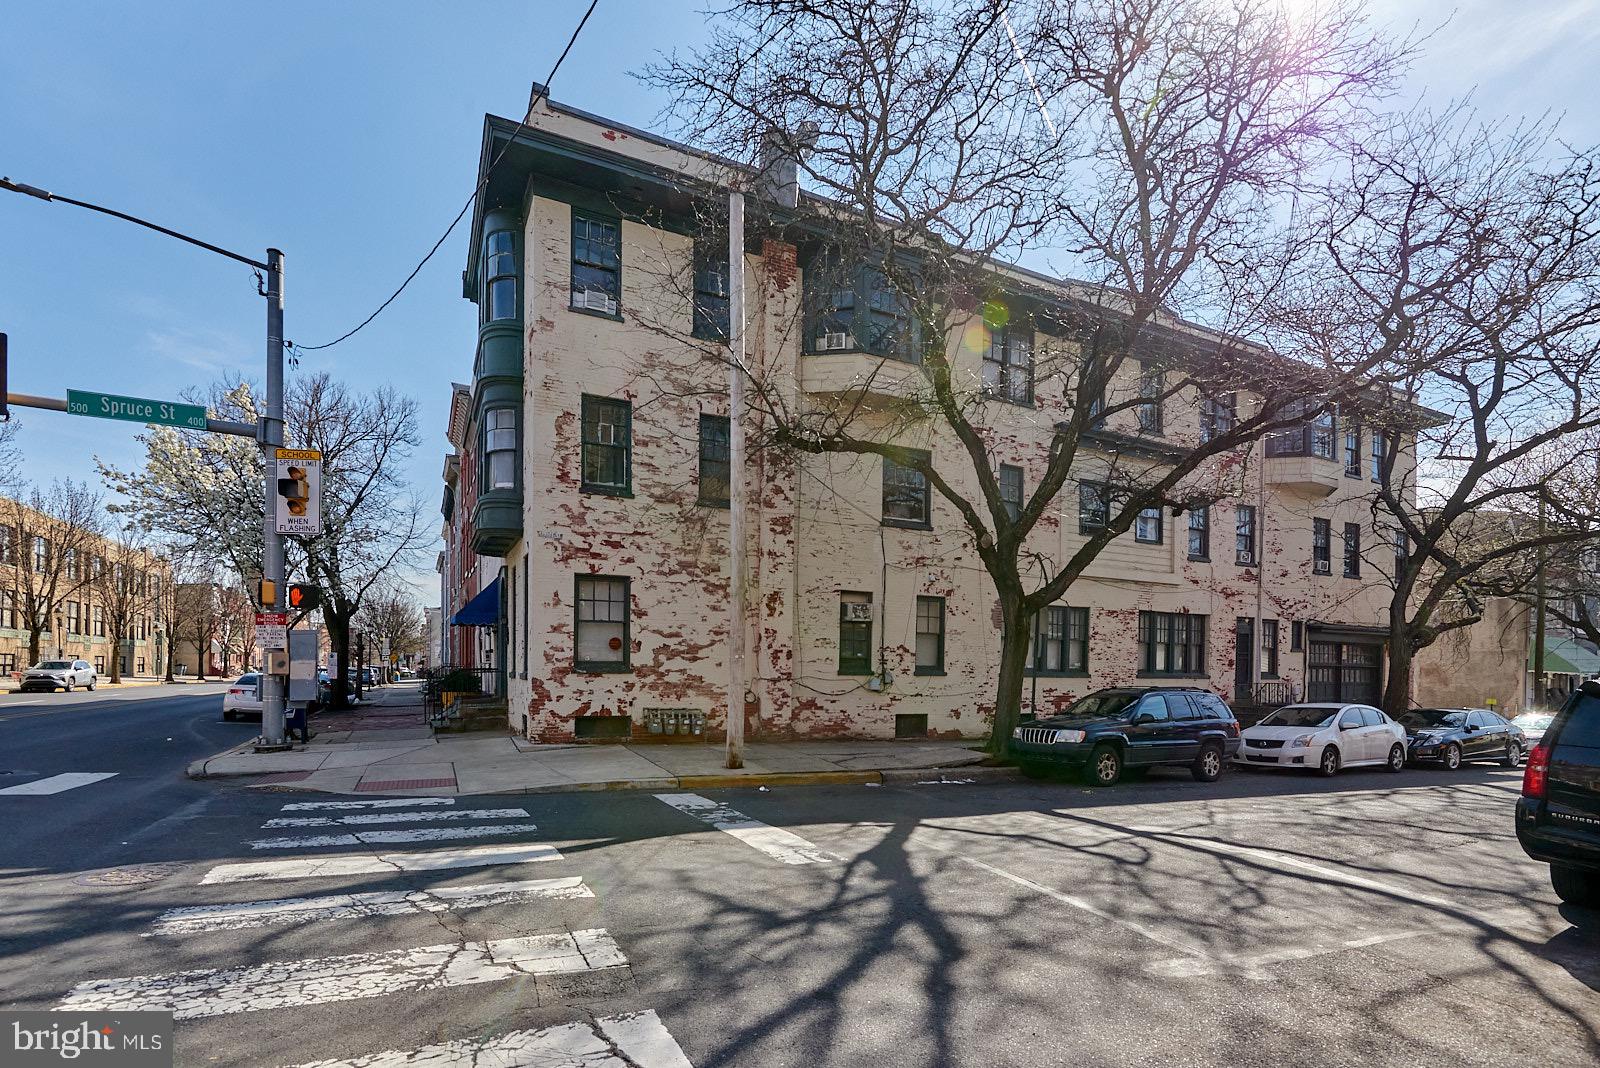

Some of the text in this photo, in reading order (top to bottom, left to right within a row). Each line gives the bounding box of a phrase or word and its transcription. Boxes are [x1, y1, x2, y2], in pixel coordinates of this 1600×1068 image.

[70, 396, 204, 427] 500 Spruce St 400
[281, 451, 314, 459] SCHOOL
[279, 459, 300, 467] SPEED
[287, 517, 309, 525] WHEN
[279, 524, 316, 532] FLASHING
